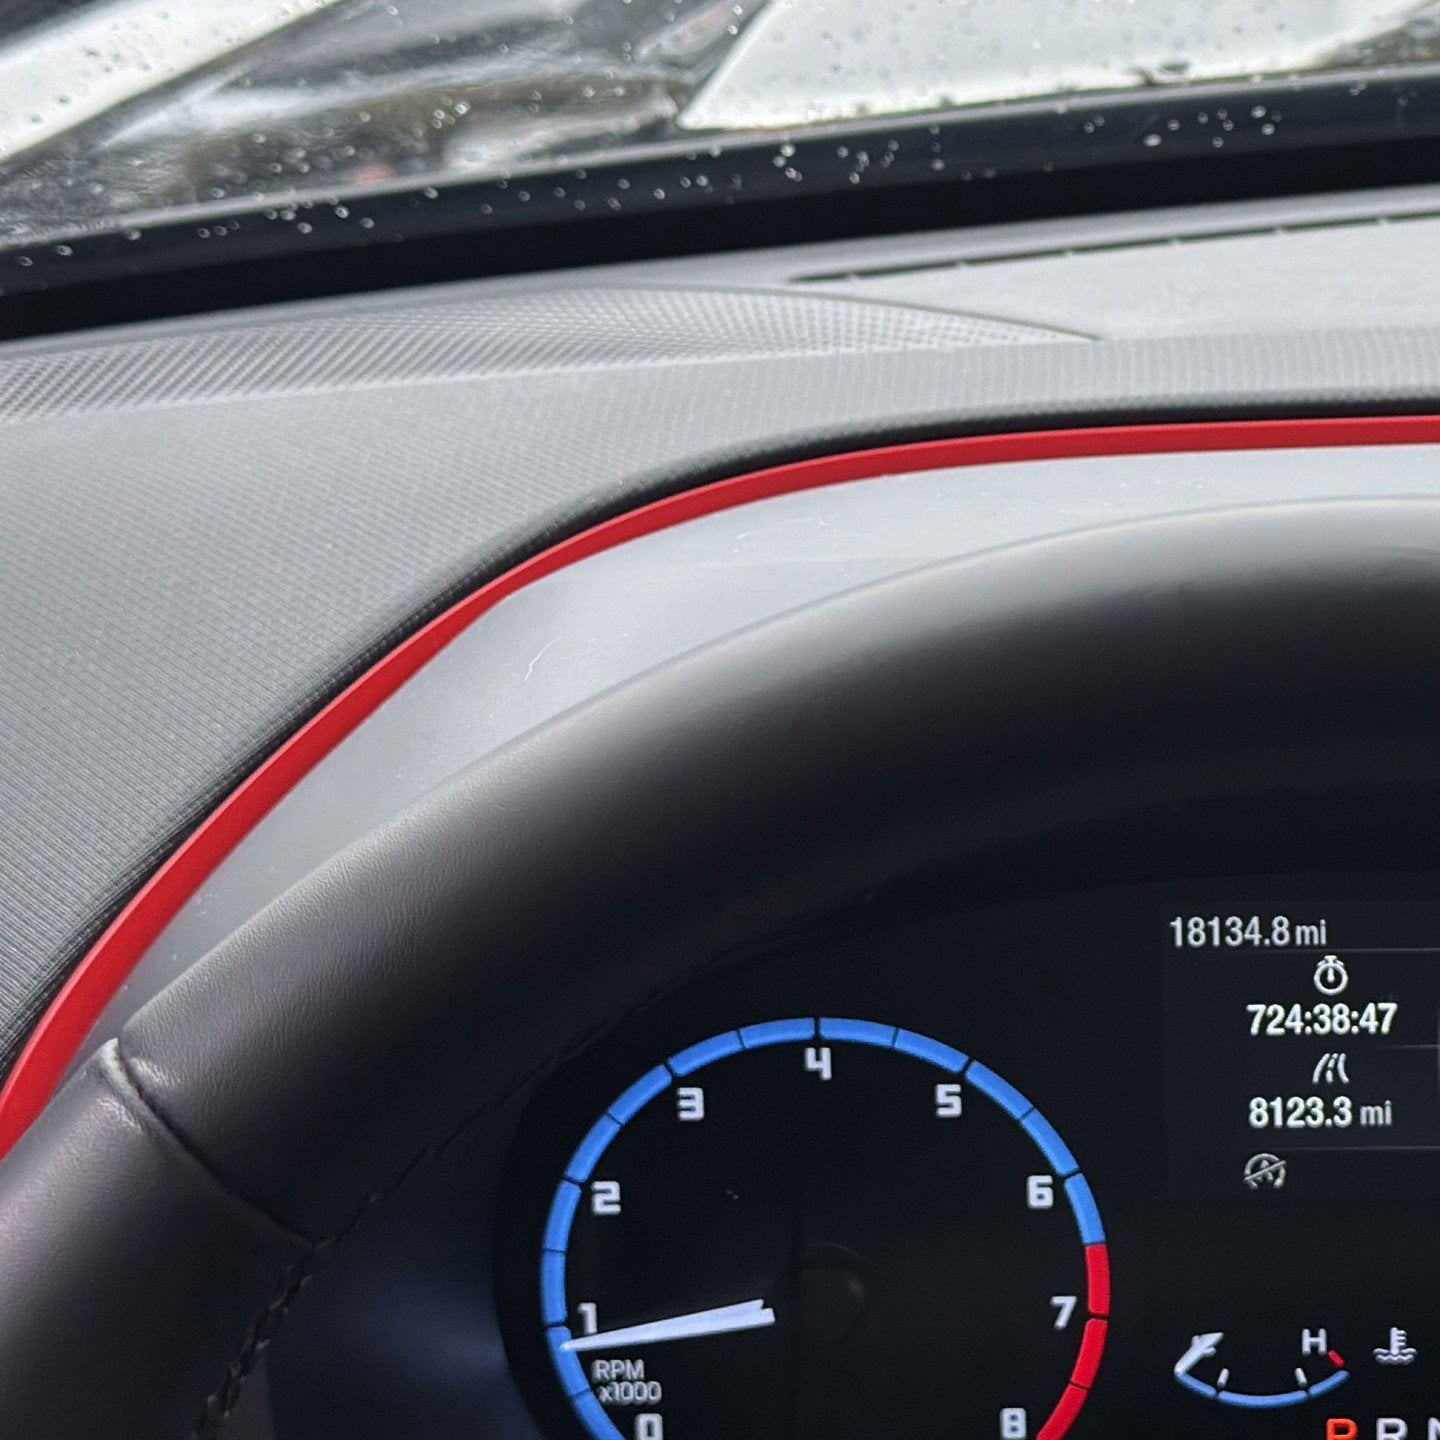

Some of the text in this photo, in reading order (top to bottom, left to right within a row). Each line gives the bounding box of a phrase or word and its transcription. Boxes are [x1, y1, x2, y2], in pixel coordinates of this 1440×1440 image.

[1169, 915, 1327, 947] 18134.8 mi
[1246, 1002, 1398, 1036] 724:38:47
[805, 1047, 832, 1080] 4
[678, 1087, 705, 1121] 3
[936, 1084, 962, 1117] 5
[1249, 1095, 1392, 1128] 8123.3 mi
[591, 1180, 621, 1215] 2
[1027, 1175, 1054, 1208] 6
[576, 1300, 600, 1338] 1
[1051, 1295, 1077, 1329] 7
[1301, 1328, 1327, 1354] H
[593, 1359, 644, 1380] RPM
[599, 1381, 662, 1402] x1000
[1001, 1407, 1027, 1440] 8
